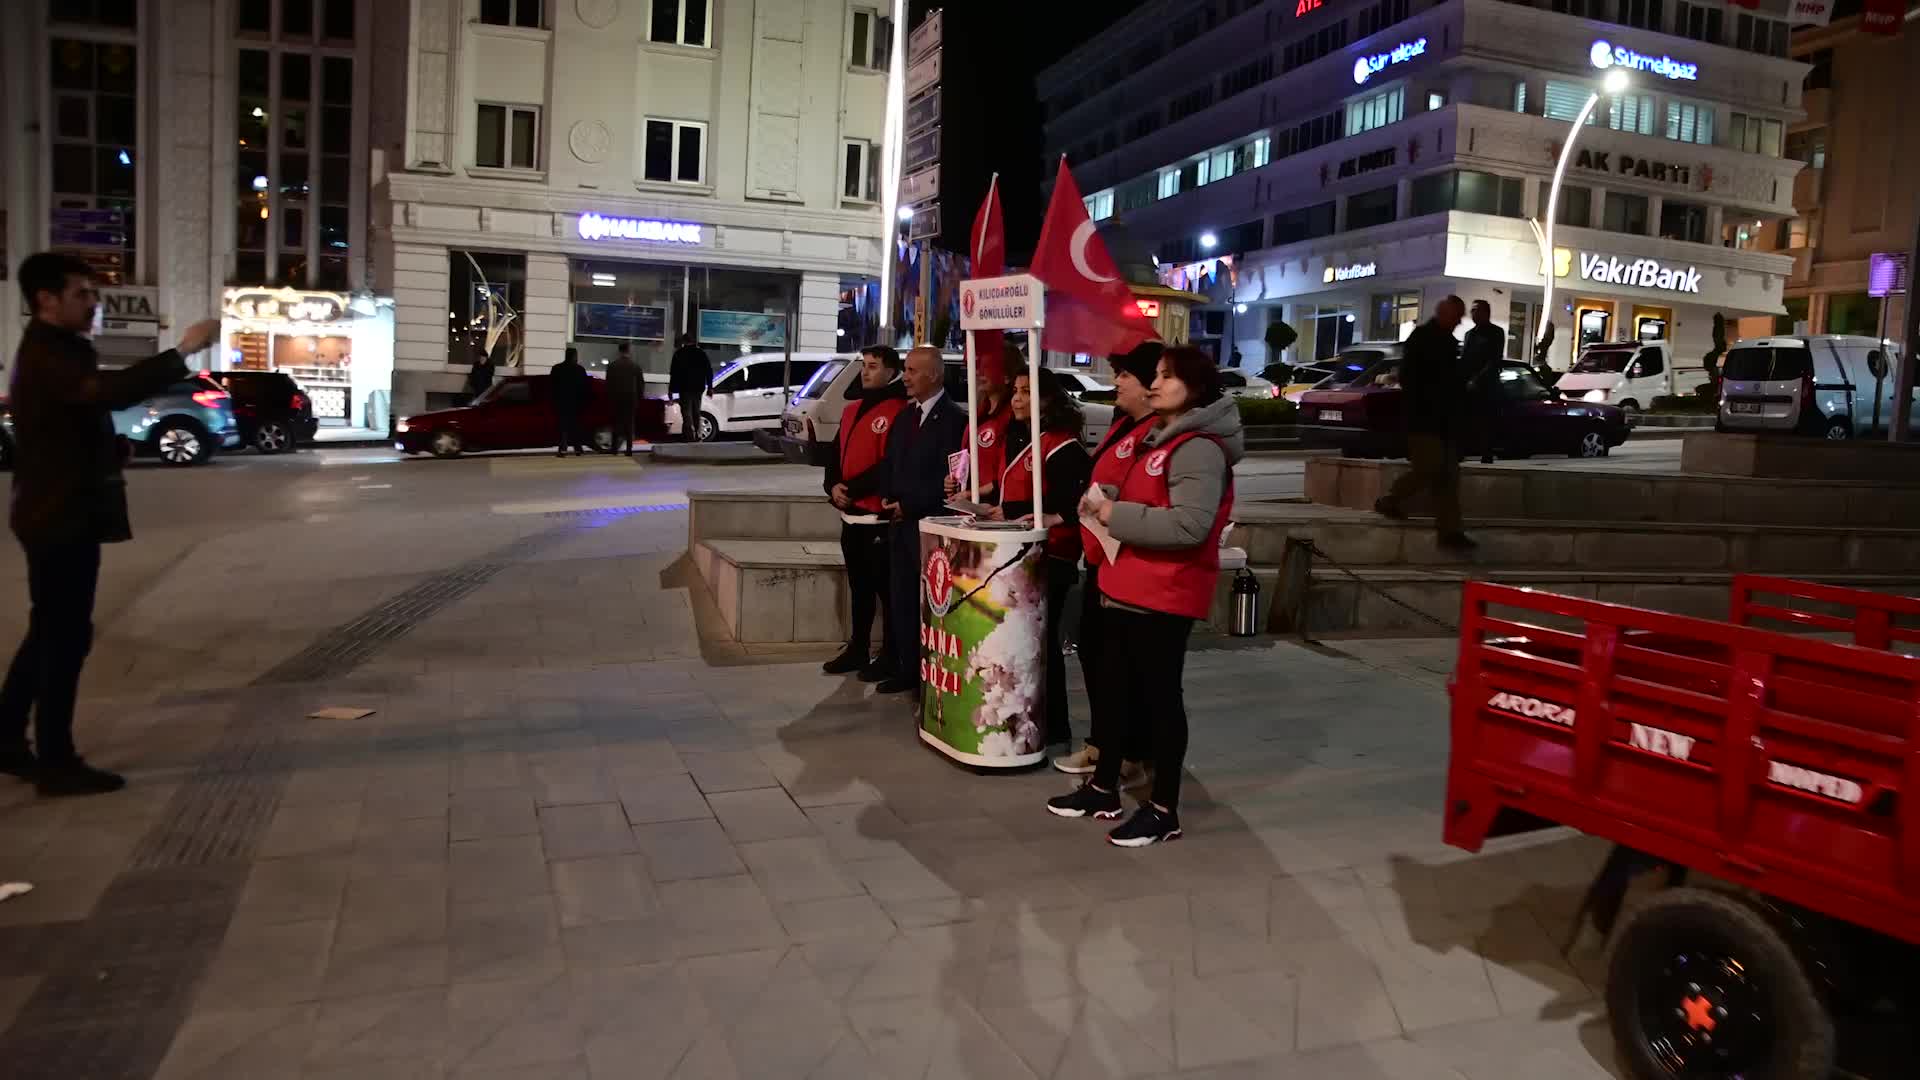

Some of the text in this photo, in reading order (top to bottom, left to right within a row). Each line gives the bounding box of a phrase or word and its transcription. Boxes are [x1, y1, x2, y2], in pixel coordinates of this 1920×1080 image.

[1575, 149, 1610, 171] AK
[921, 622, 959, 660] SANA
[1487, 691, 1577, 727] ARORA
[1628, 722, 1697, 762] NEW
